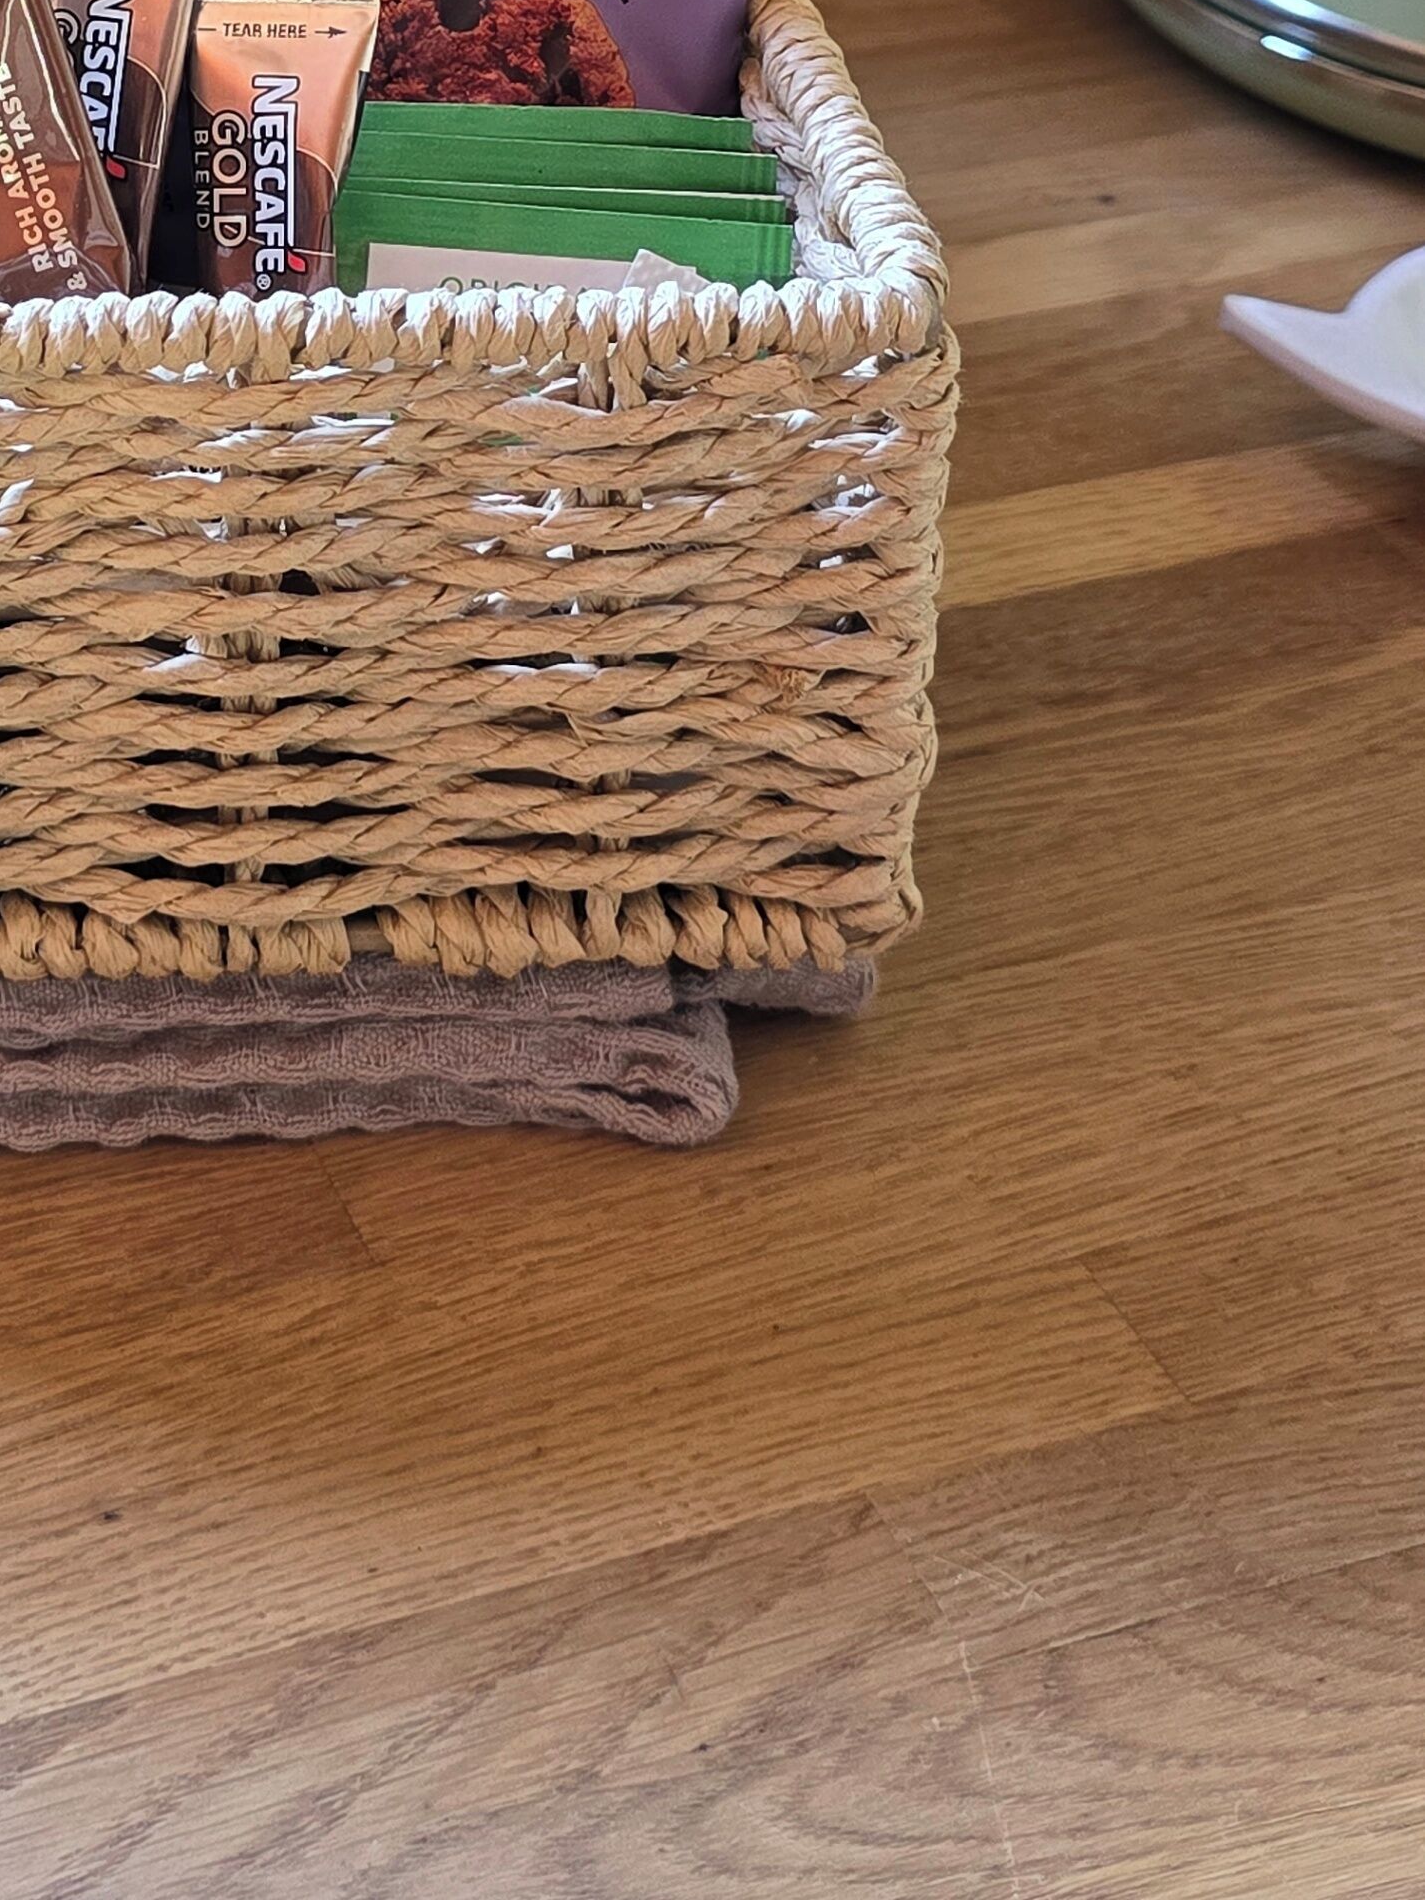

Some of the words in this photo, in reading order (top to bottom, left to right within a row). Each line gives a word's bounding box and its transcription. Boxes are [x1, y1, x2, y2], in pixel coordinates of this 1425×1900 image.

[223, 22, 262, 39] TEAR
[267, 23, 307, 39] HERE
[23, 152, 79, 269] SMOOTH
[194, 129, 211, 229] BLEND
[212, 111, 247, 248] GOLD
[14, 206, 54, 273] RICH
[67, 270, 88, 291] &
